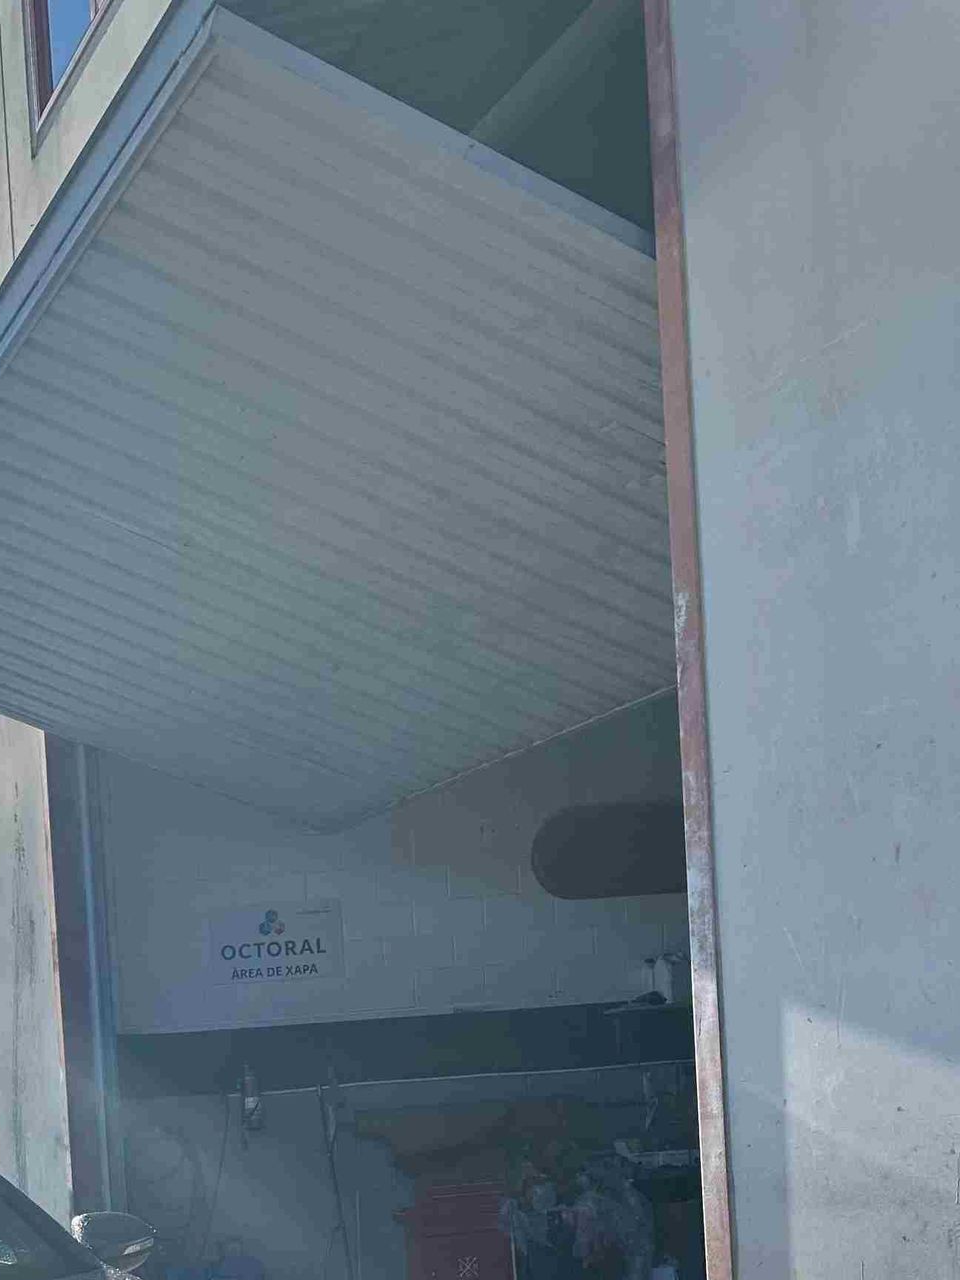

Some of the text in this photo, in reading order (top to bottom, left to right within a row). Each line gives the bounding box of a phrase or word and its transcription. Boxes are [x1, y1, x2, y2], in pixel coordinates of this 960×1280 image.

[221, 938, 326, 960] OCTORAL
[266, 966, 283, 977] DE
[285, 963, 318, 977] XAPA
